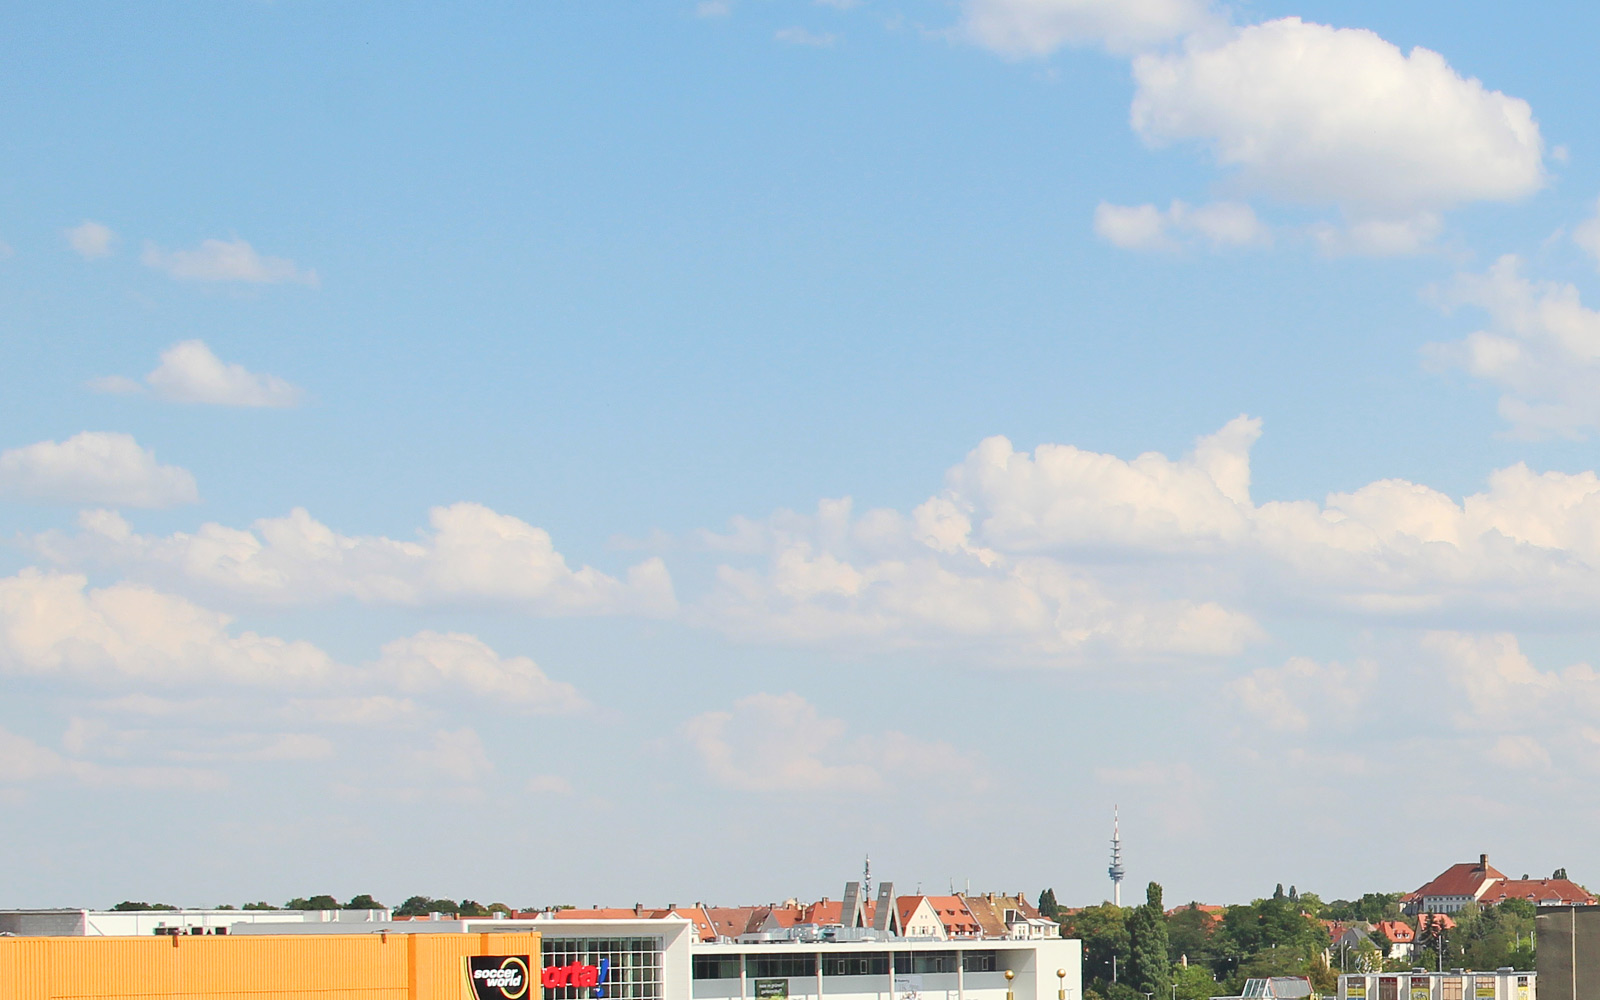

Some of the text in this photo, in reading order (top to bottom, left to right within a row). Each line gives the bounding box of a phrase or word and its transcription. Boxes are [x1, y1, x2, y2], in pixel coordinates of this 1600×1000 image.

[473, 968, 519, 979] soccer
[541, 957, 609, 998] orta!
[486, 974, 522, 987] world
